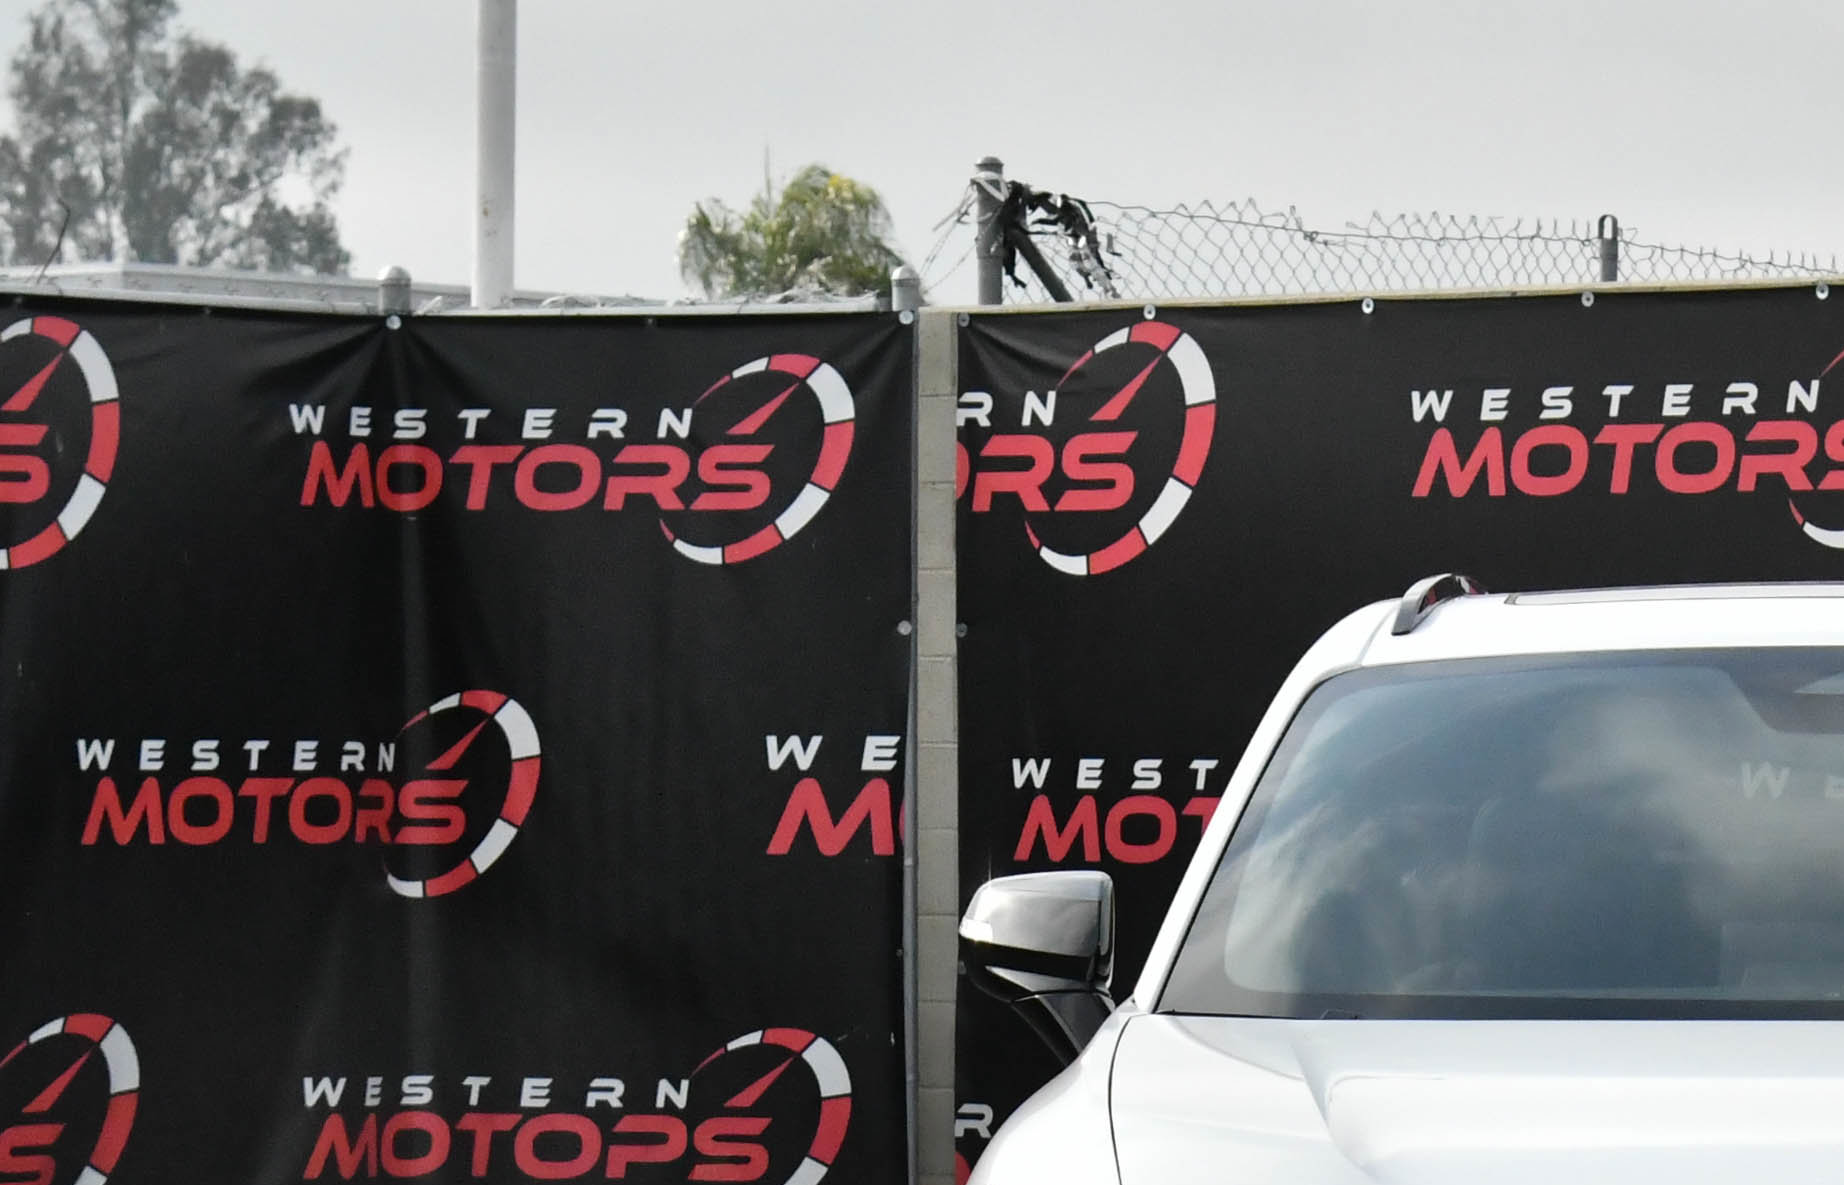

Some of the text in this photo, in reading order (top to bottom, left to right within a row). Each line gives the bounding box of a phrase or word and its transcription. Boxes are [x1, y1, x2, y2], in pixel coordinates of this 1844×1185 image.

[1411, 380, 1819, 422] WESTERN
[289, 404, 693, 438] WESTERN
[301, 441, 775, 512] MOTORS
[956, 431, 1139, 512] RS
[77, 740, 396, 771] WESTERN
[765, 735, 901, 771] WE
[1012, 758, 1219, 790] WEST
[81, 776, 469, 846] MOTORS
[303, 1075, 689, 1109] WESTERN
